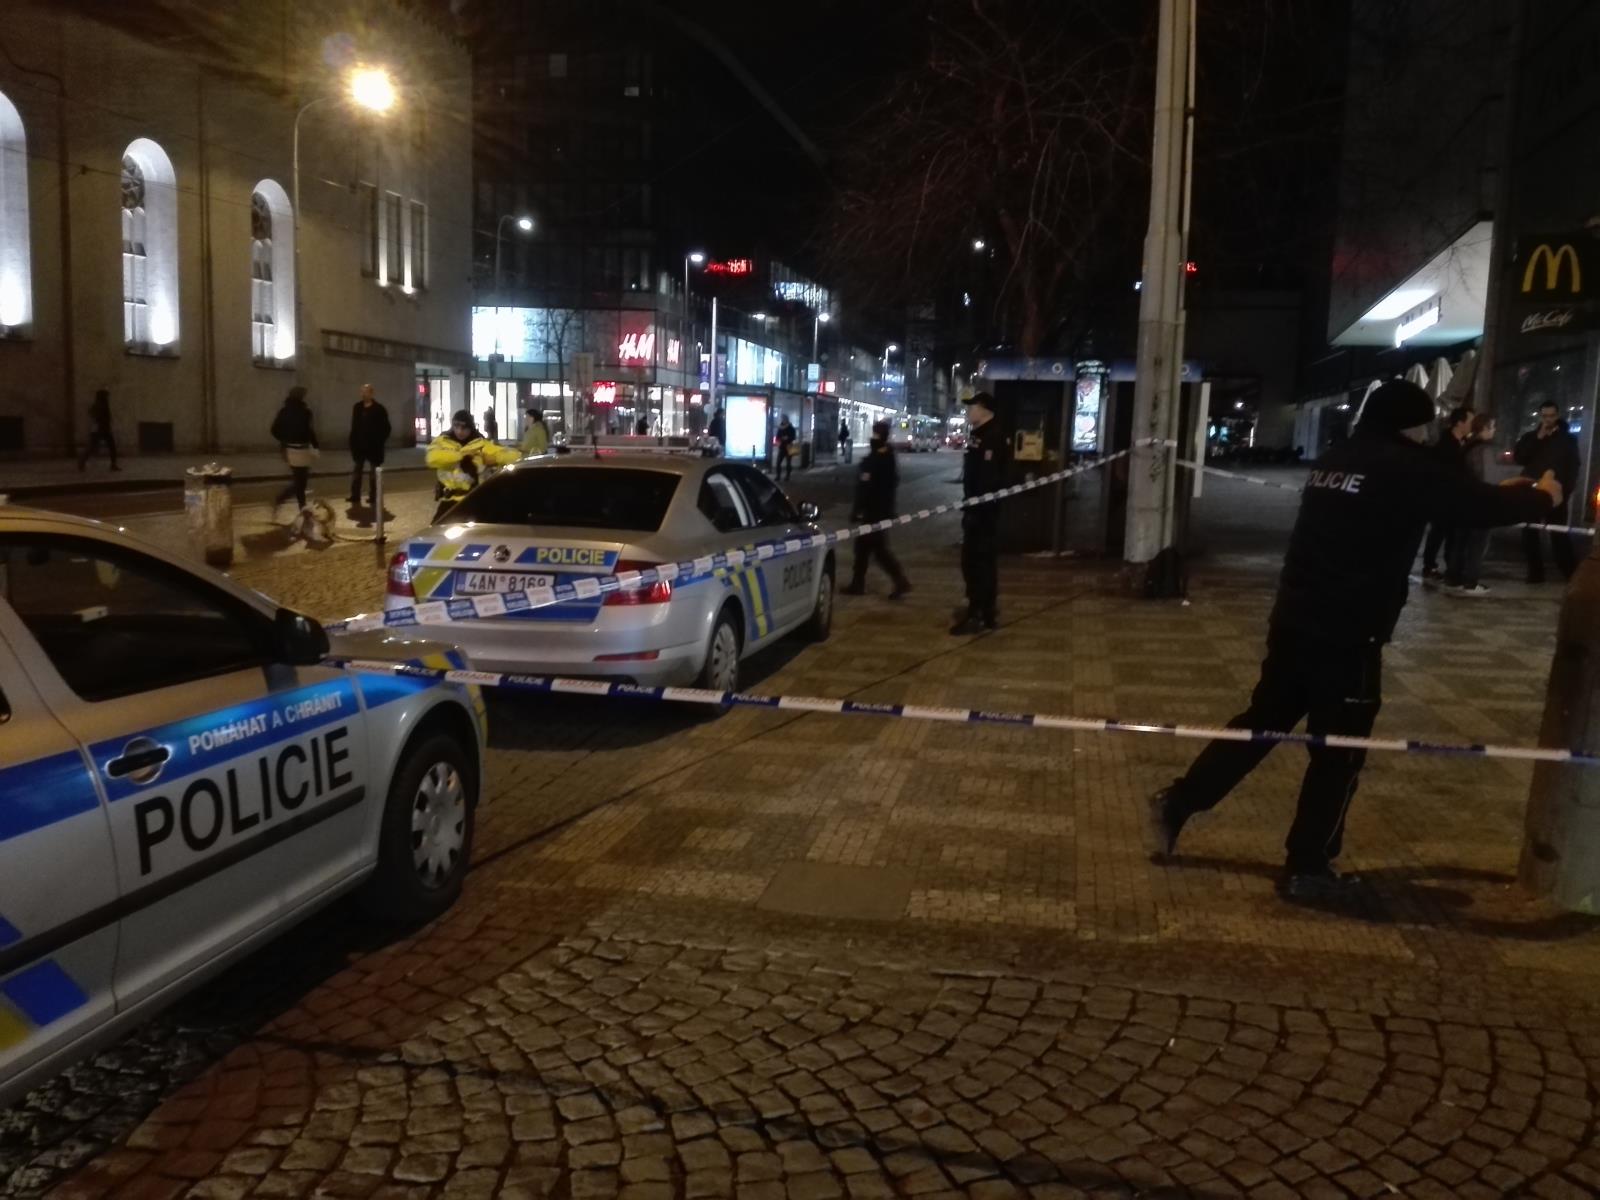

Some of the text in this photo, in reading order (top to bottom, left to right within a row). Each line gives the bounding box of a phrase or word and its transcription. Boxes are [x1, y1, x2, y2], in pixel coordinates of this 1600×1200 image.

[619, 333, 655, 360] H&M
[536, 548, 605, 565] POLICIE
[469, 573, 497, 591] 4AN
[188, 691, 343, 755] POMÁHAT A CHRÁNIT
[134, 726, 354, 876] POLICIE
